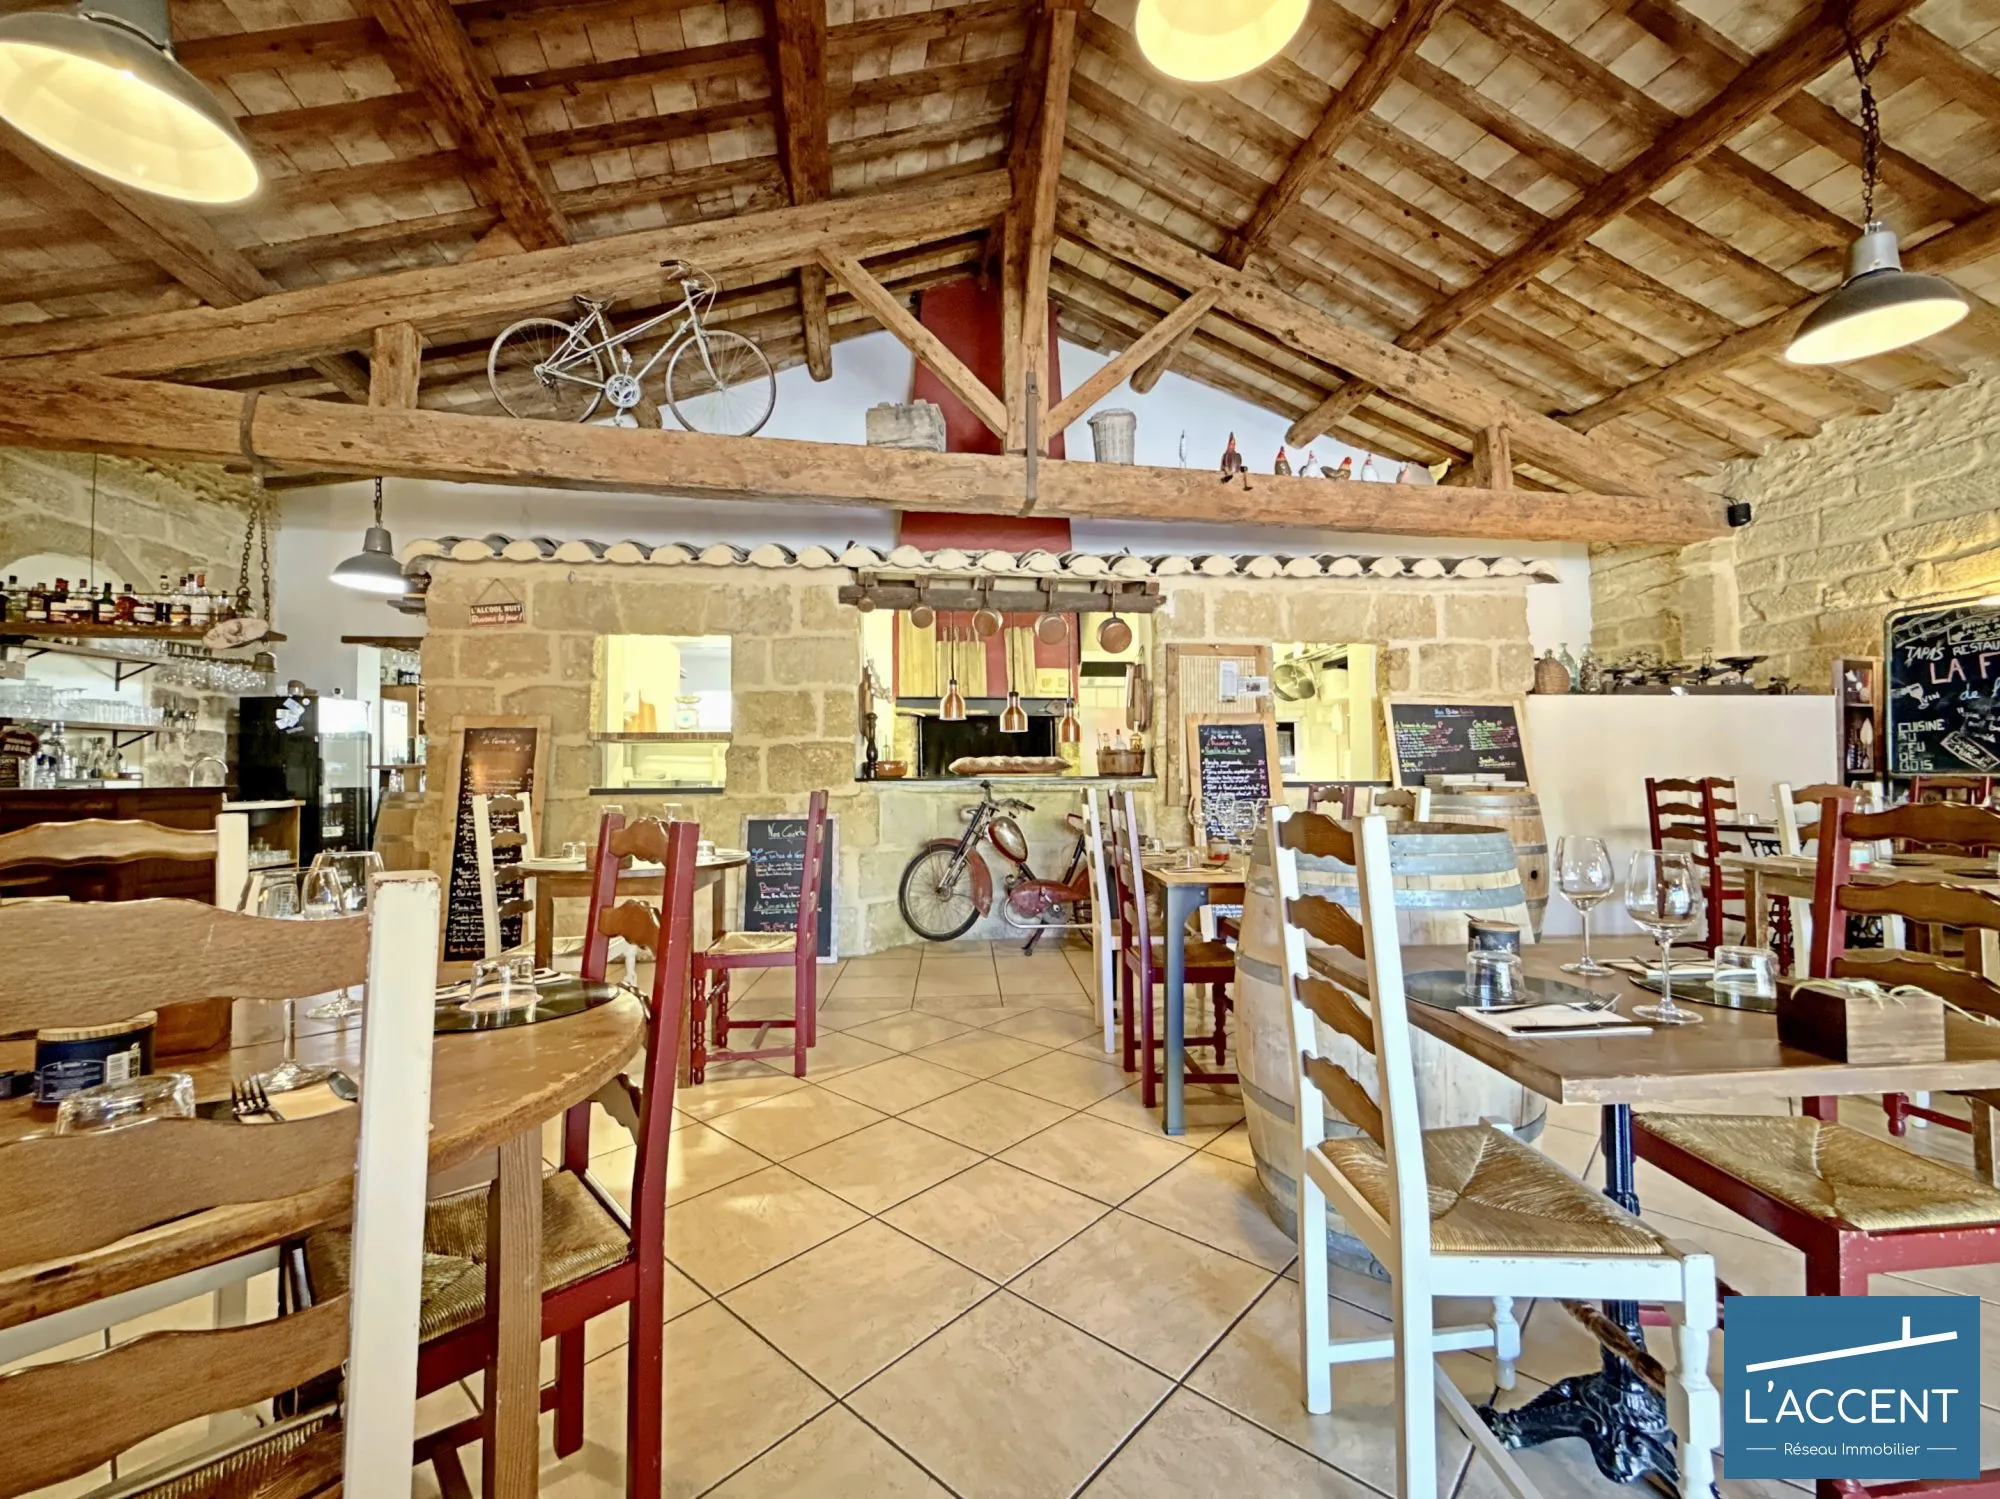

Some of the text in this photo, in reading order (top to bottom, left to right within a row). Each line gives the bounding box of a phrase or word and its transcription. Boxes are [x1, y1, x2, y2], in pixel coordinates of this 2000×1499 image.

[470, 606, 503, 614] L'ALCOOL
[1905, 646, 1945, 661] TAPAS
[1930, 658, 1967, 685] LA
[1922, 691, 1940, 703] VIN
[1959, 683, 1981, 701] de
[1898, 719, 1945, 733] CUISINE
[1898, 733, 1917, 741] AU
[1899, 760, 1934, 771] BOIS
